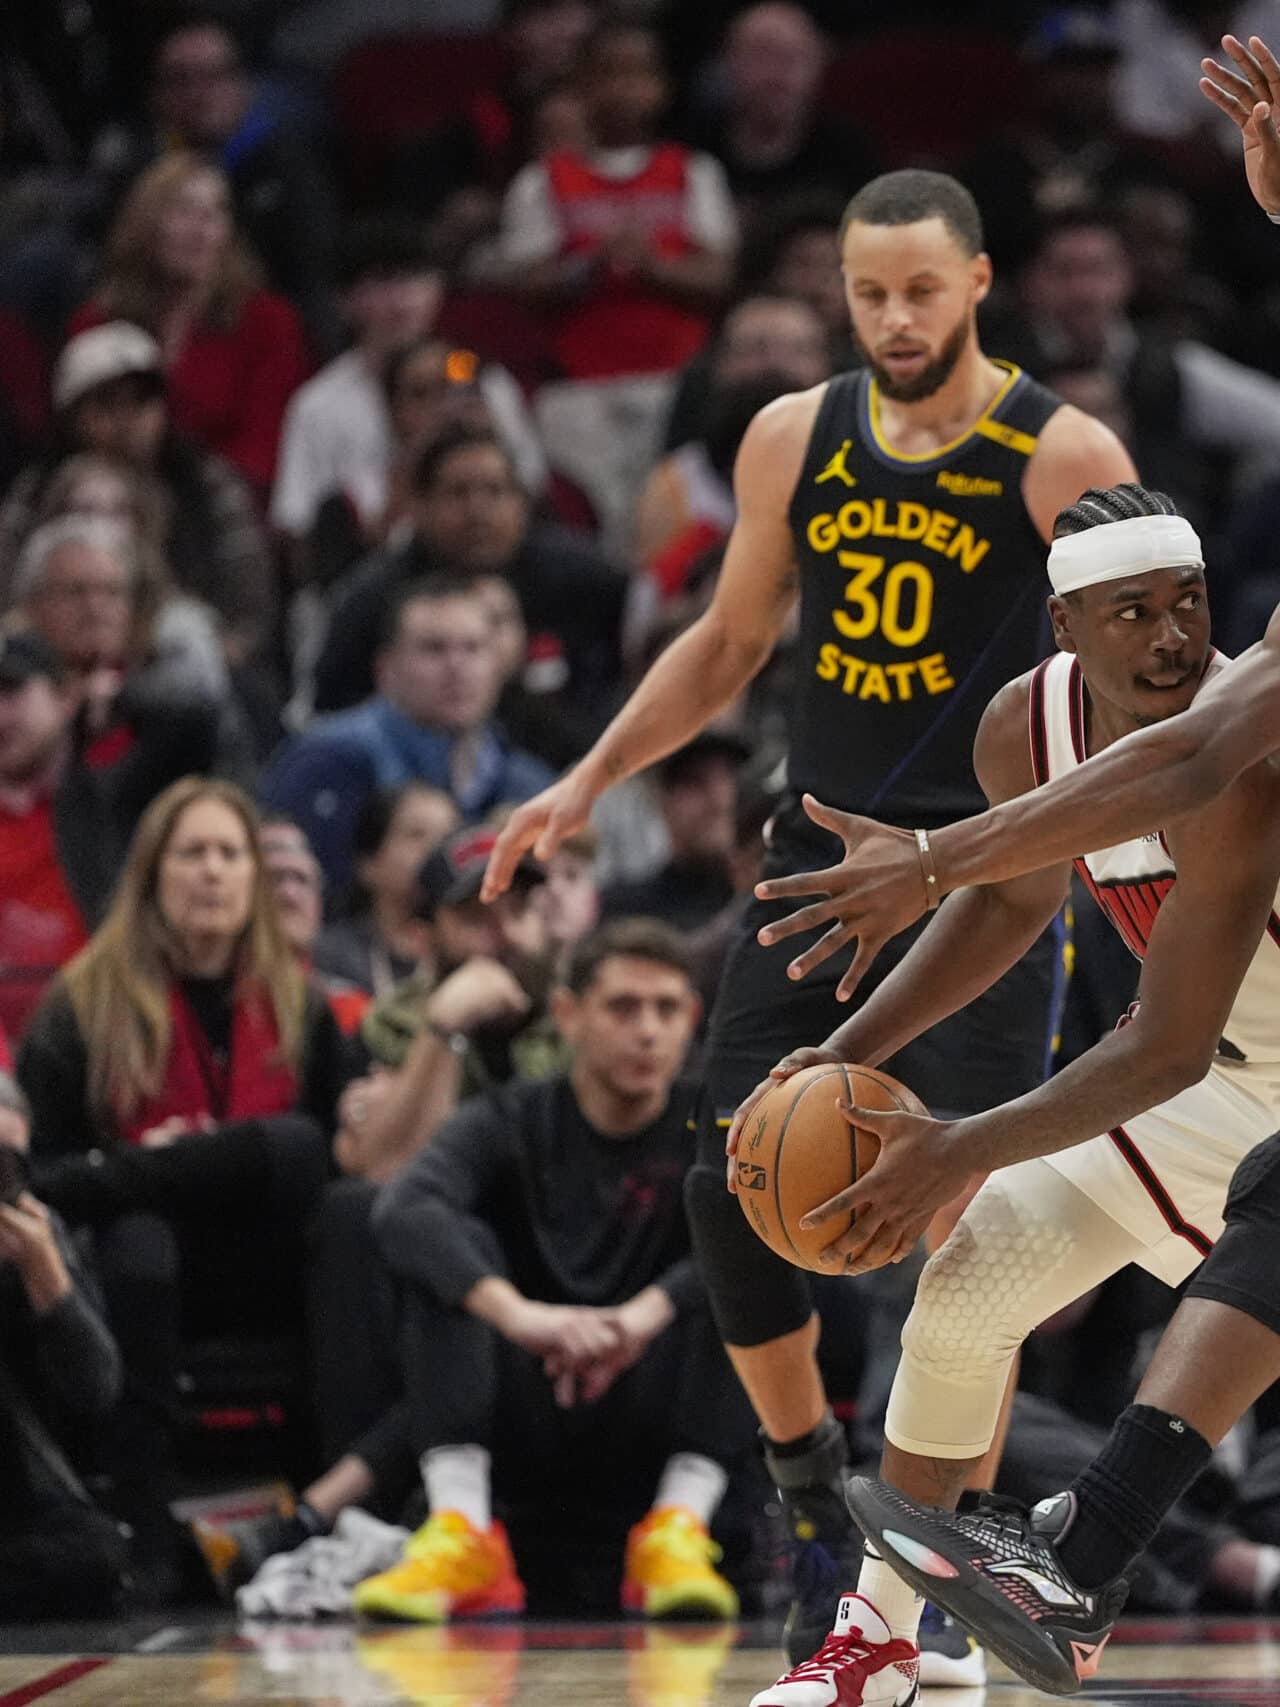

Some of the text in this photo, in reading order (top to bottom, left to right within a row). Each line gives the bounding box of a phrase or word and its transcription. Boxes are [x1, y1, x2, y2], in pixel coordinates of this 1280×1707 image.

[807, 498, 991, 573] GOLDEN
[832, 551, 934, 648] 30
[816, 643, 955, 703] STATE
